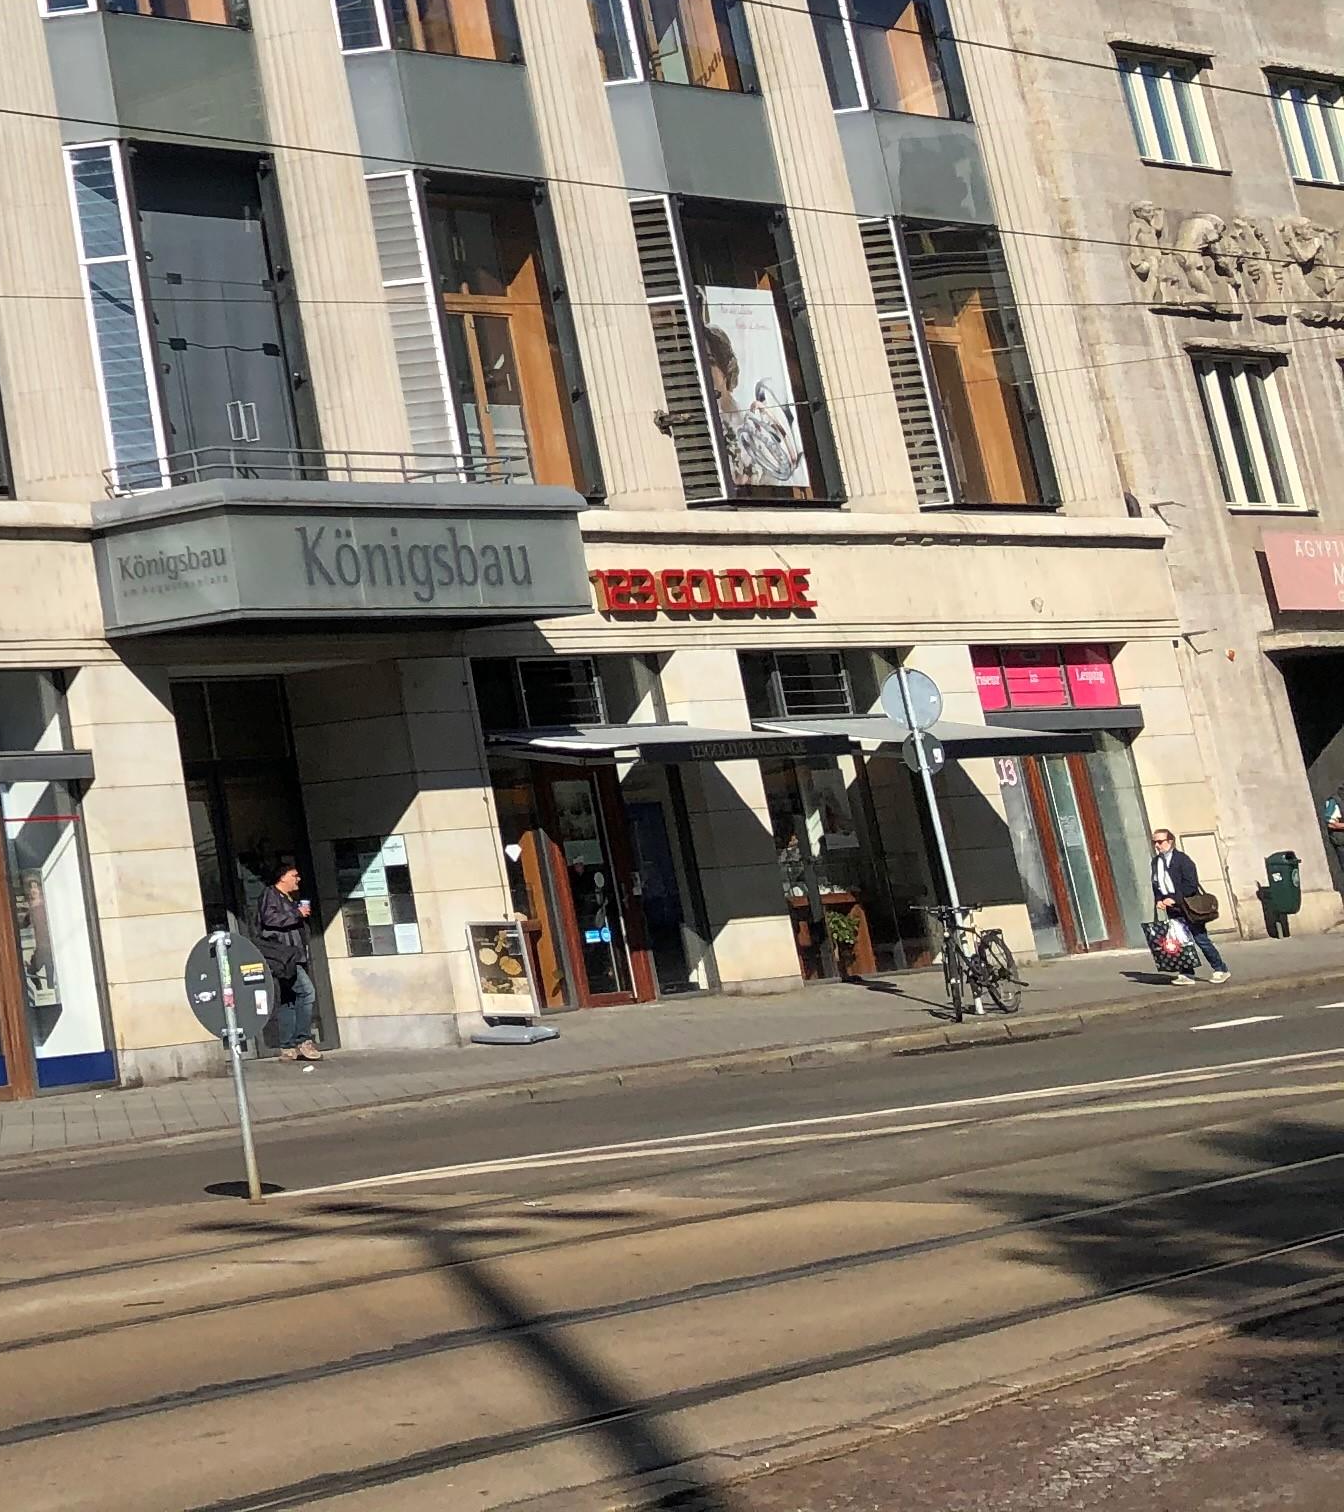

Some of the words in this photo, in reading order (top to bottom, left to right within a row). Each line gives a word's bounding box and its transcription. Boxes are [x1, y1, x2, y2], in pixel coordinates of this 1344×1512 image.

[117, 545, 226, 581] Königsbau
[295, 525, 533, 603] Königsbau
[590, 568, 818, 611] 123GOLD.DE
[1075, 668, 1105, 684] Leipzig
[998, 759, 1018, 786] 13
